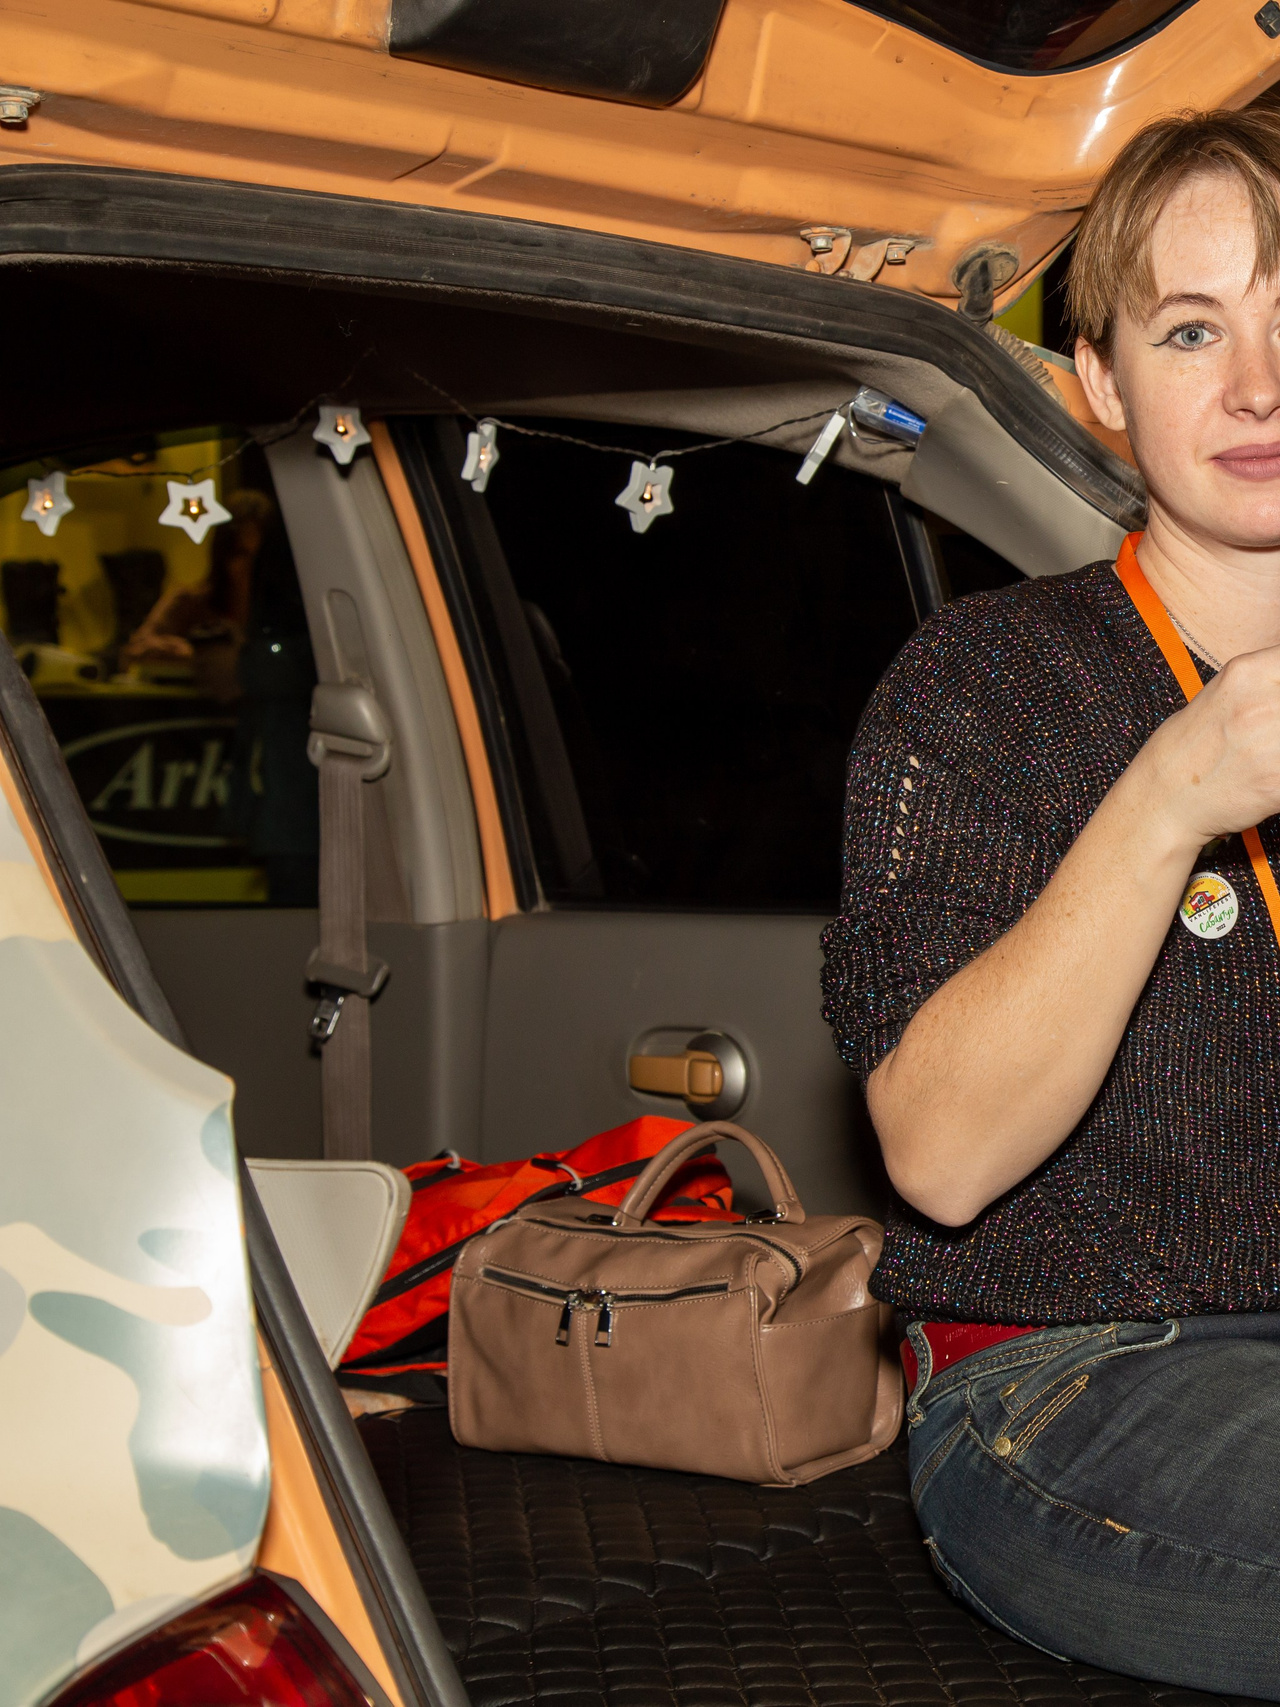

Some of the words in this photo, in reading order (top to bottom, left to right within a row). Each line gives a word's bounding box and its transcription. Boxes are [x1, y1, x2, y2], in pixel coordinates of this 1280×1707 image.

[91, 739, 240, 810] Ark
[1190, 895, 1232, 922] VANLIFEFEST
[1216, 923, 1226, 932] 2022
